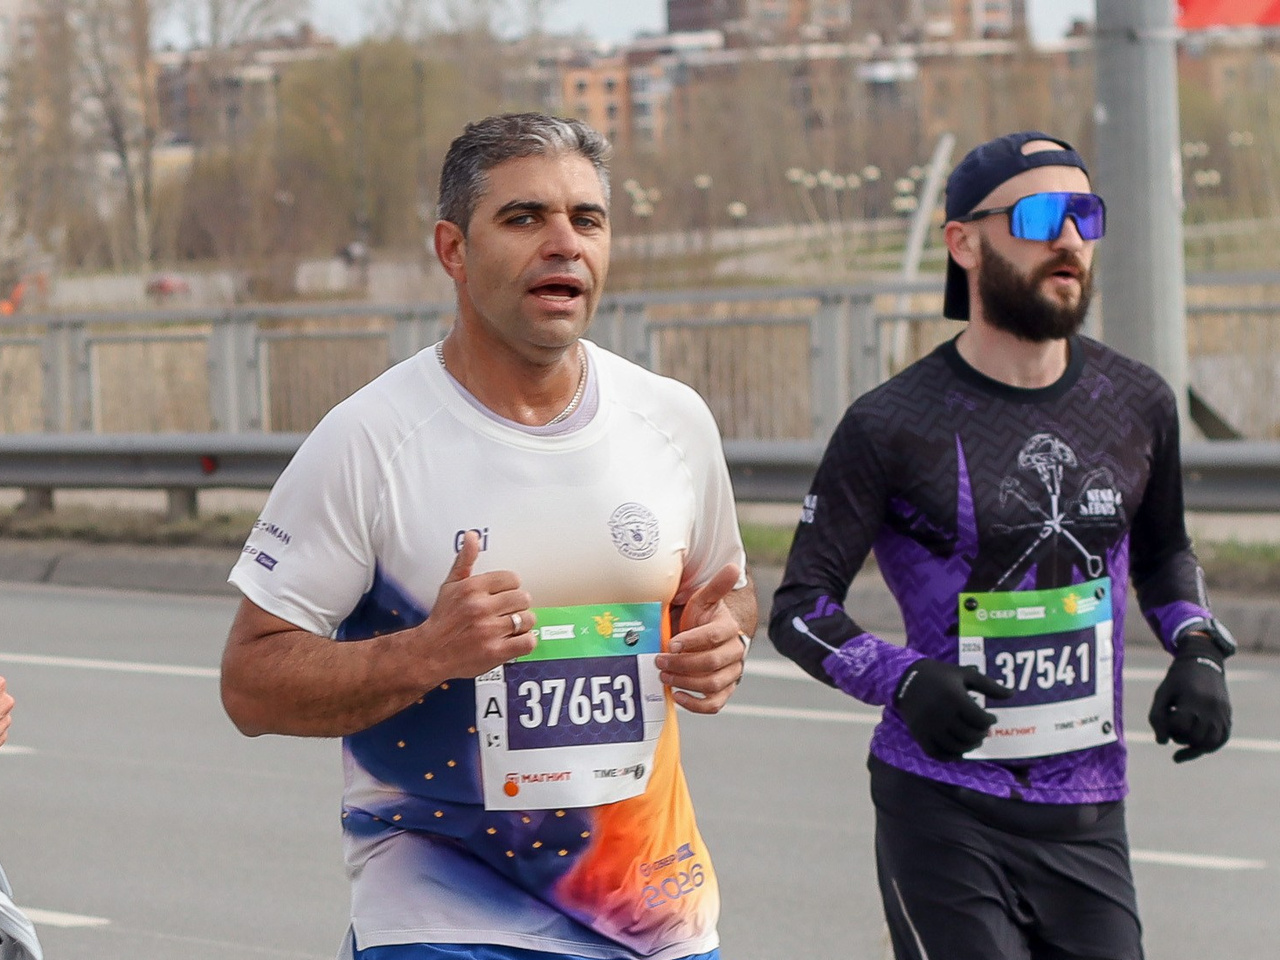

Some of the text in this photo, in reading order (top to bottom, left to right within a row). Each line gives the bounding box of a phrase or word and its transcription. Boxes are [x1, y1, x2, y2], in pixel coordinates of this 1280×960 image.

[995, 642, 1090, 691] 37541
[483, 697, 503, 719] A
[518, 674, 636, 728] 37653
[521, 771, 571, 783] МАГНИТ
[641, 863, 705, 909] 2026
